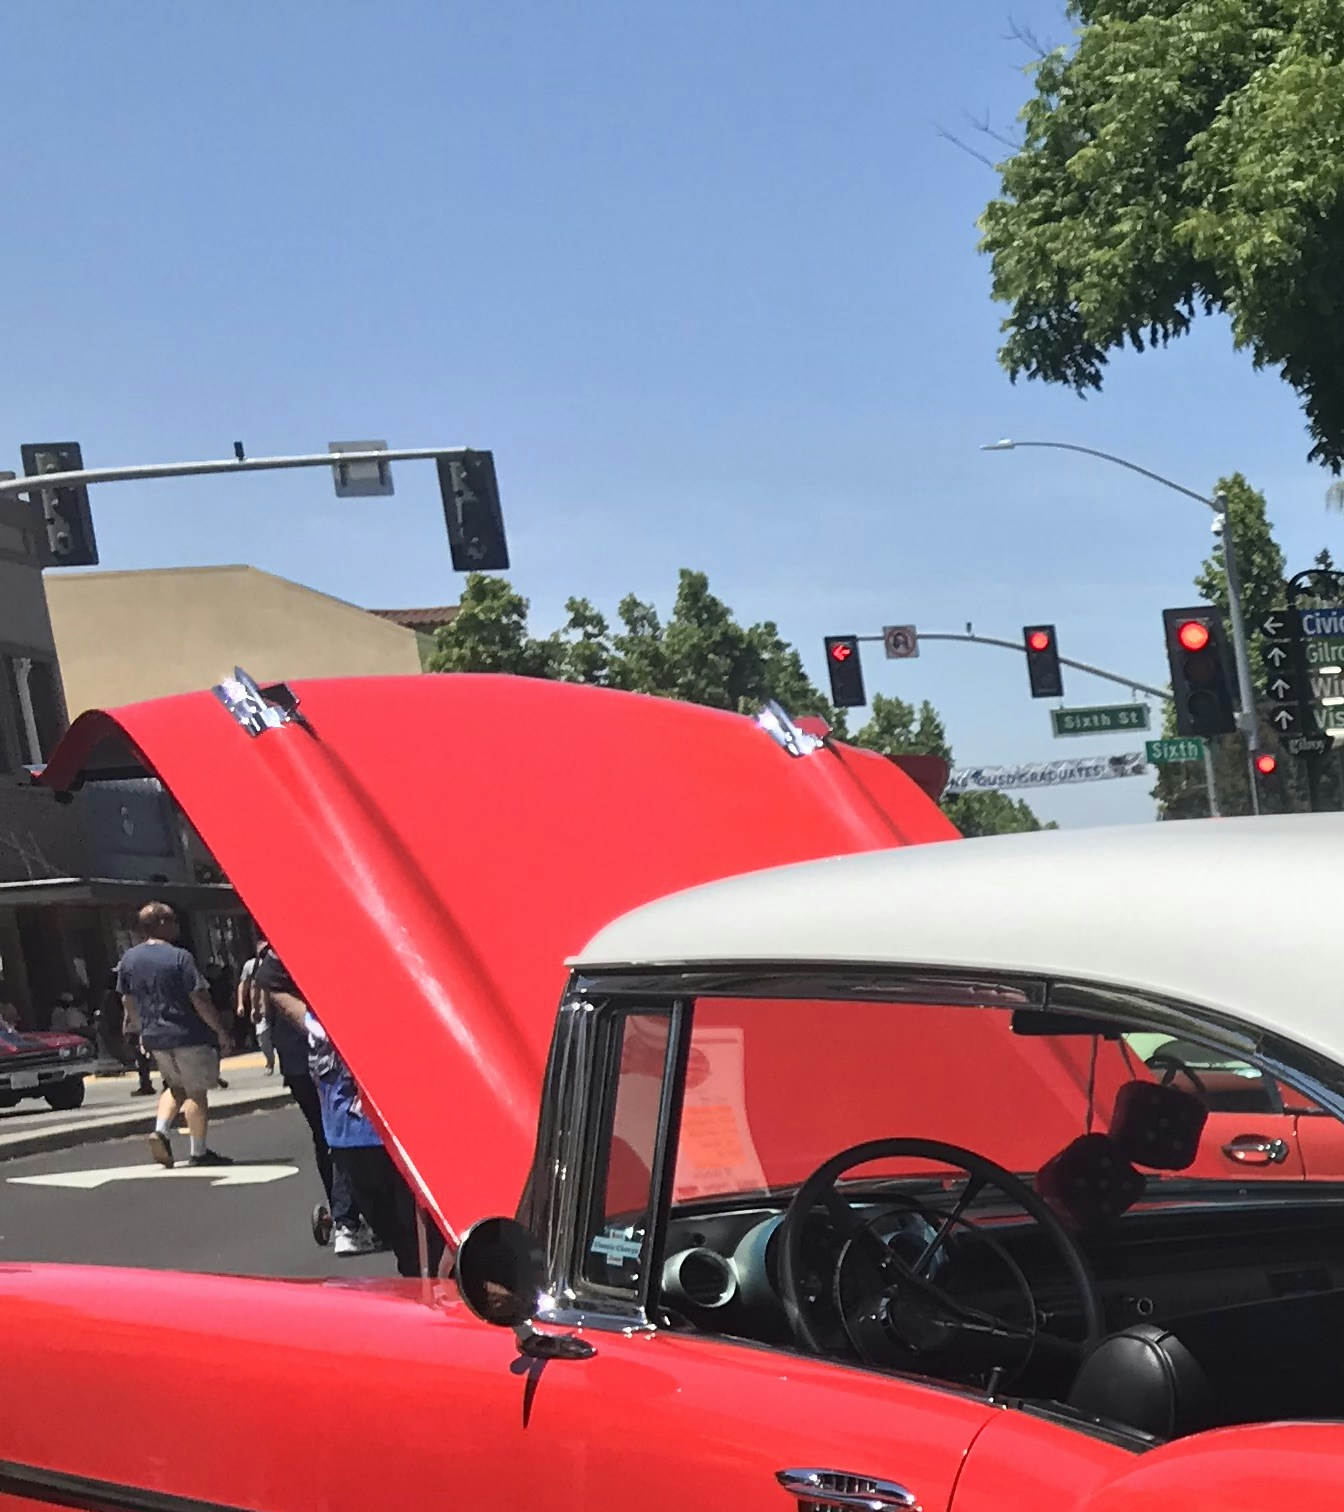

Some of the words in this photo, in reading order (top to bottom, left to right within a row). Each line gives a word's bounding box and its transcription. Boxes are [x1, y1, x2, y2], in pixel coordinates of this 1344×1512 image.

[1064, 713, 1111, 729] Sixth
[1118, 711, 1138, 725] St
[1151, 740, 1198, 759] Sixth
